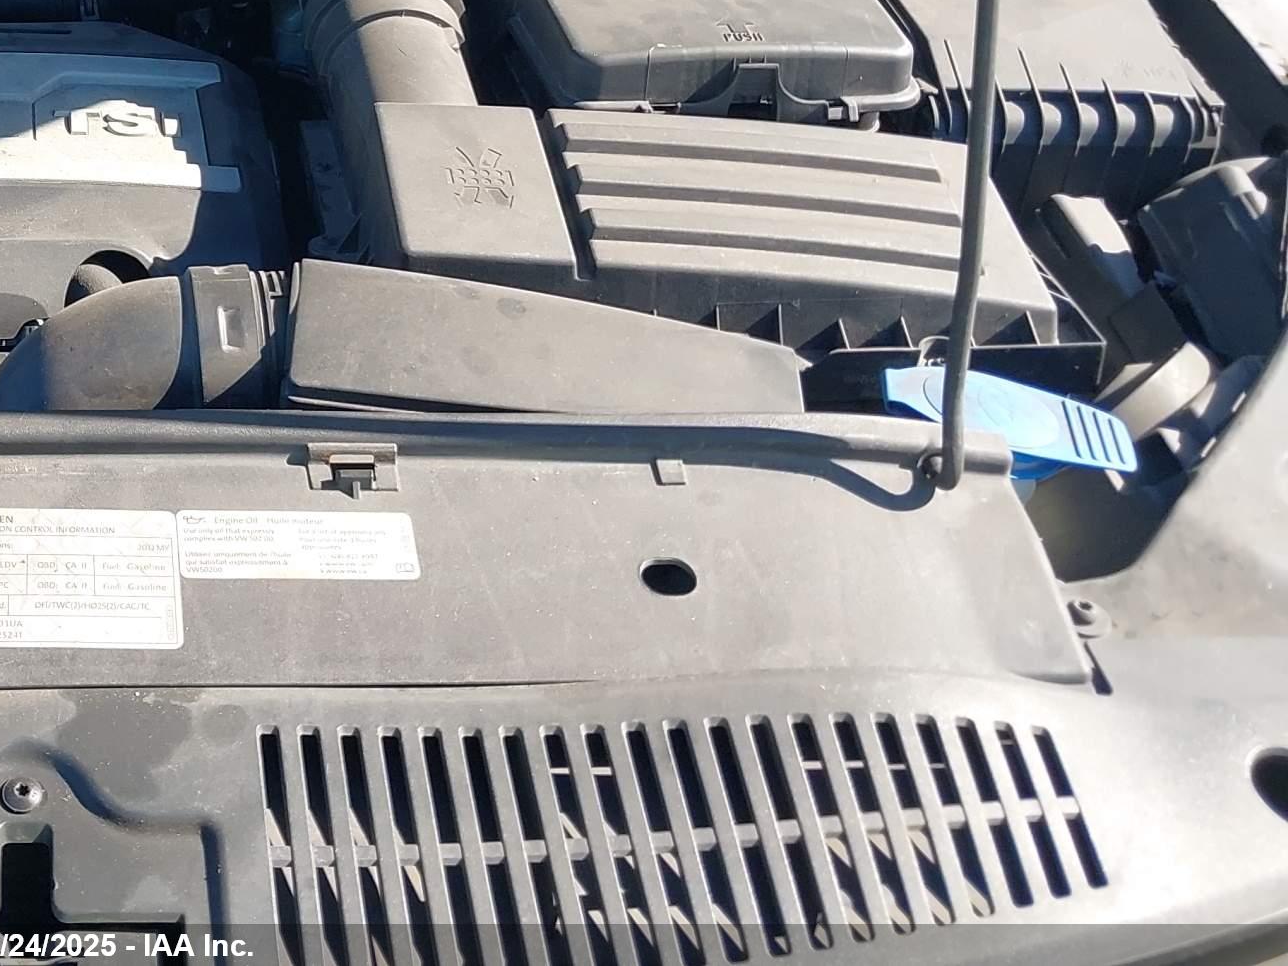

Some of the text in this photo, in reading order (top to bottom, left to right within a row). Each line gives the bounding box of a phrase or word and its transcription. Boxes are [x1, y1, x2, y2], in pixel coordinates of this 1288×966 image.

[722, 32, 765, 43] PUSH
[52, 102, 183, 138] TSI
[214, 516, 243, 526] Engine
[245, 516, 258, 524] Oil
[55, 526, 115, 534] INFORMATION
